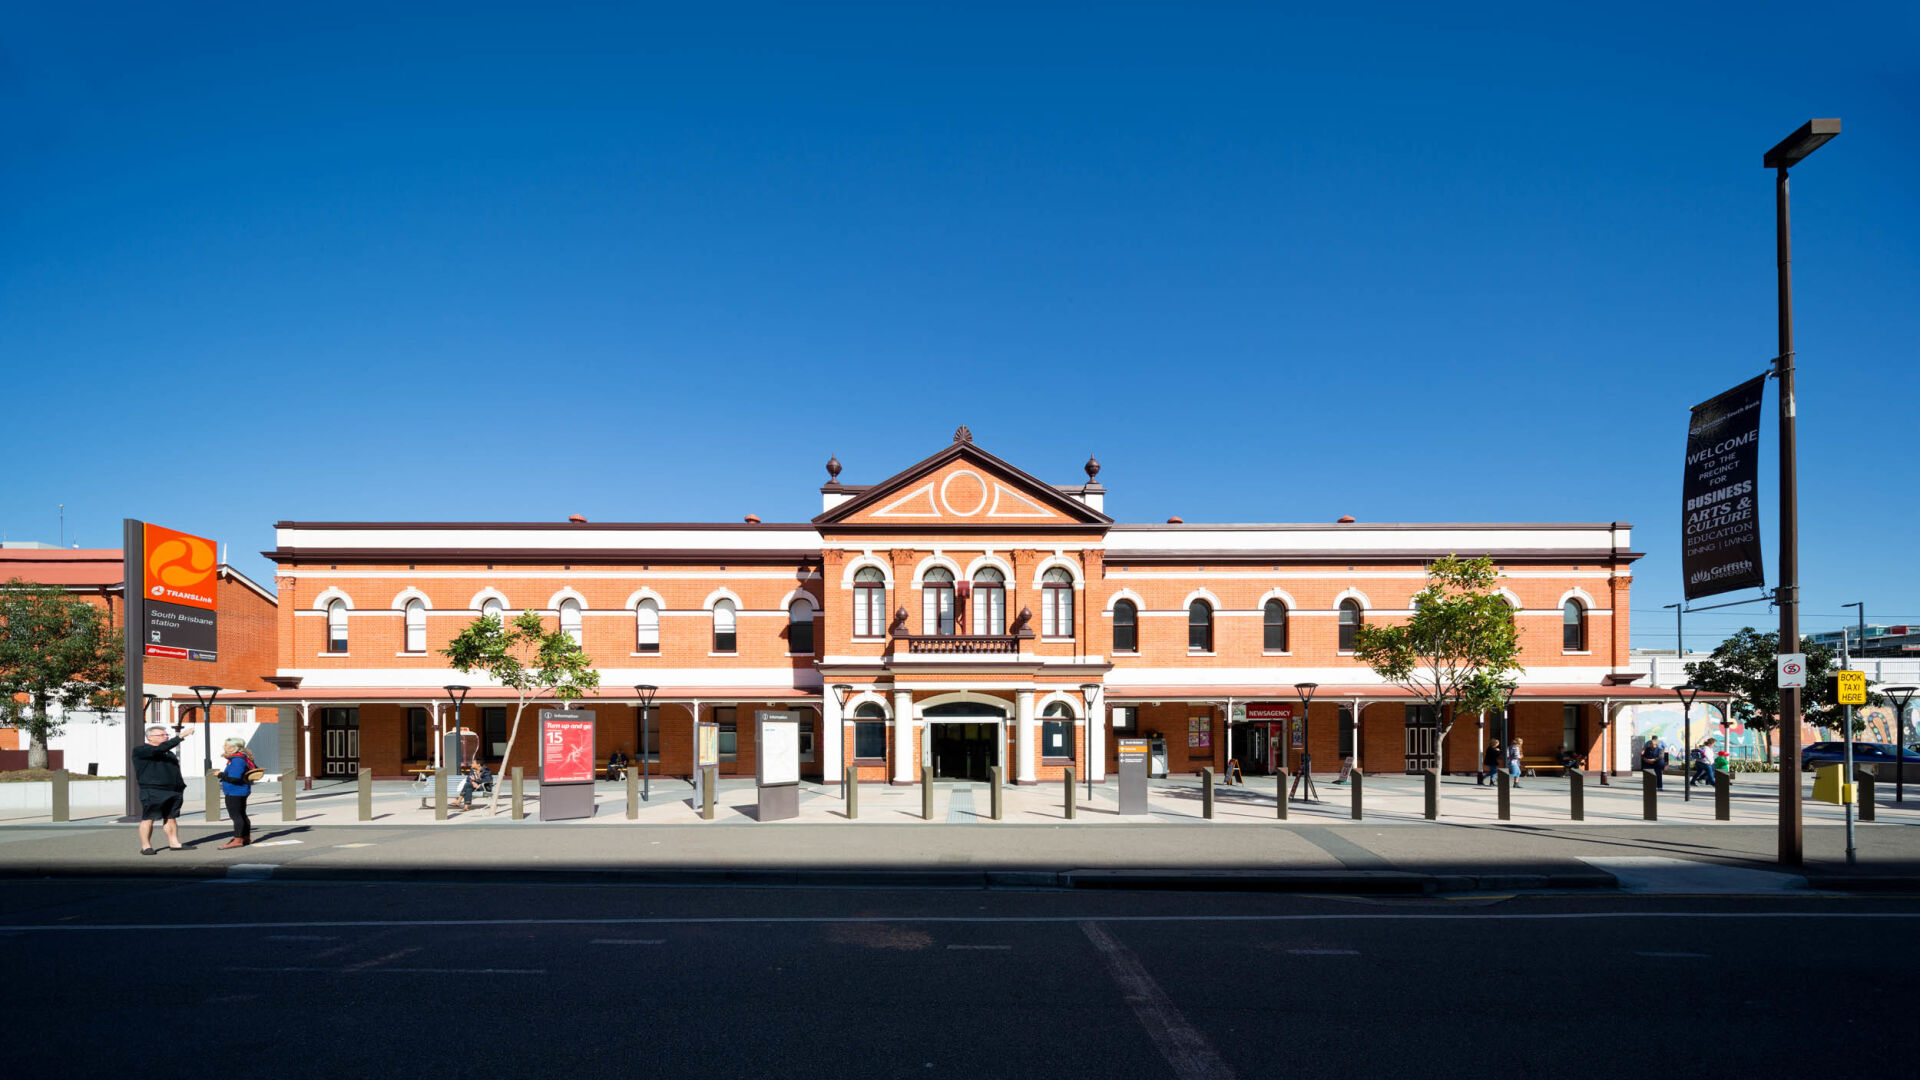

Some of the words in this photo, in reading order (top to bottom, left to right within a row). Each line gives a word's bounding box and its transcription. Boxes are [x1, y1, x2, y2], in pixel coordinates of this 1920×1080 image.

[1688, 430, 1758, 466] WELCOME
[1704, 460, 1716, 470] TO
[1720, 452, 1736, 464] THE
[1698, 460, 1740, 480] PRECINCT
[1710, 475, 1727, 486] FOR
[1687, 480, 1752, 512] BUSINESS
[1687, 502, 1732, 526] ARTS
[1736, 496, 1752, 510] &
[1686, 508, 1752, 535] CULTURE
[1688, 522, 1752, 546] EDUCATION
[1688, 543, 1716, 556] DINING
[1724, 534, 1754, 548] LIVING
[1710, 560, 1752, 575] Griffith
[150, 610, 176, 620] South
[178, 614, 214, 626] Brisbane
[150, 619, 180, 628] station
[1840, 674, 1862, 682] BOOK
[1843, 684, 1860, 692] TAXI
[1842, 694, 1862, 702] HERE
[546, 732, 563, 744] 15
